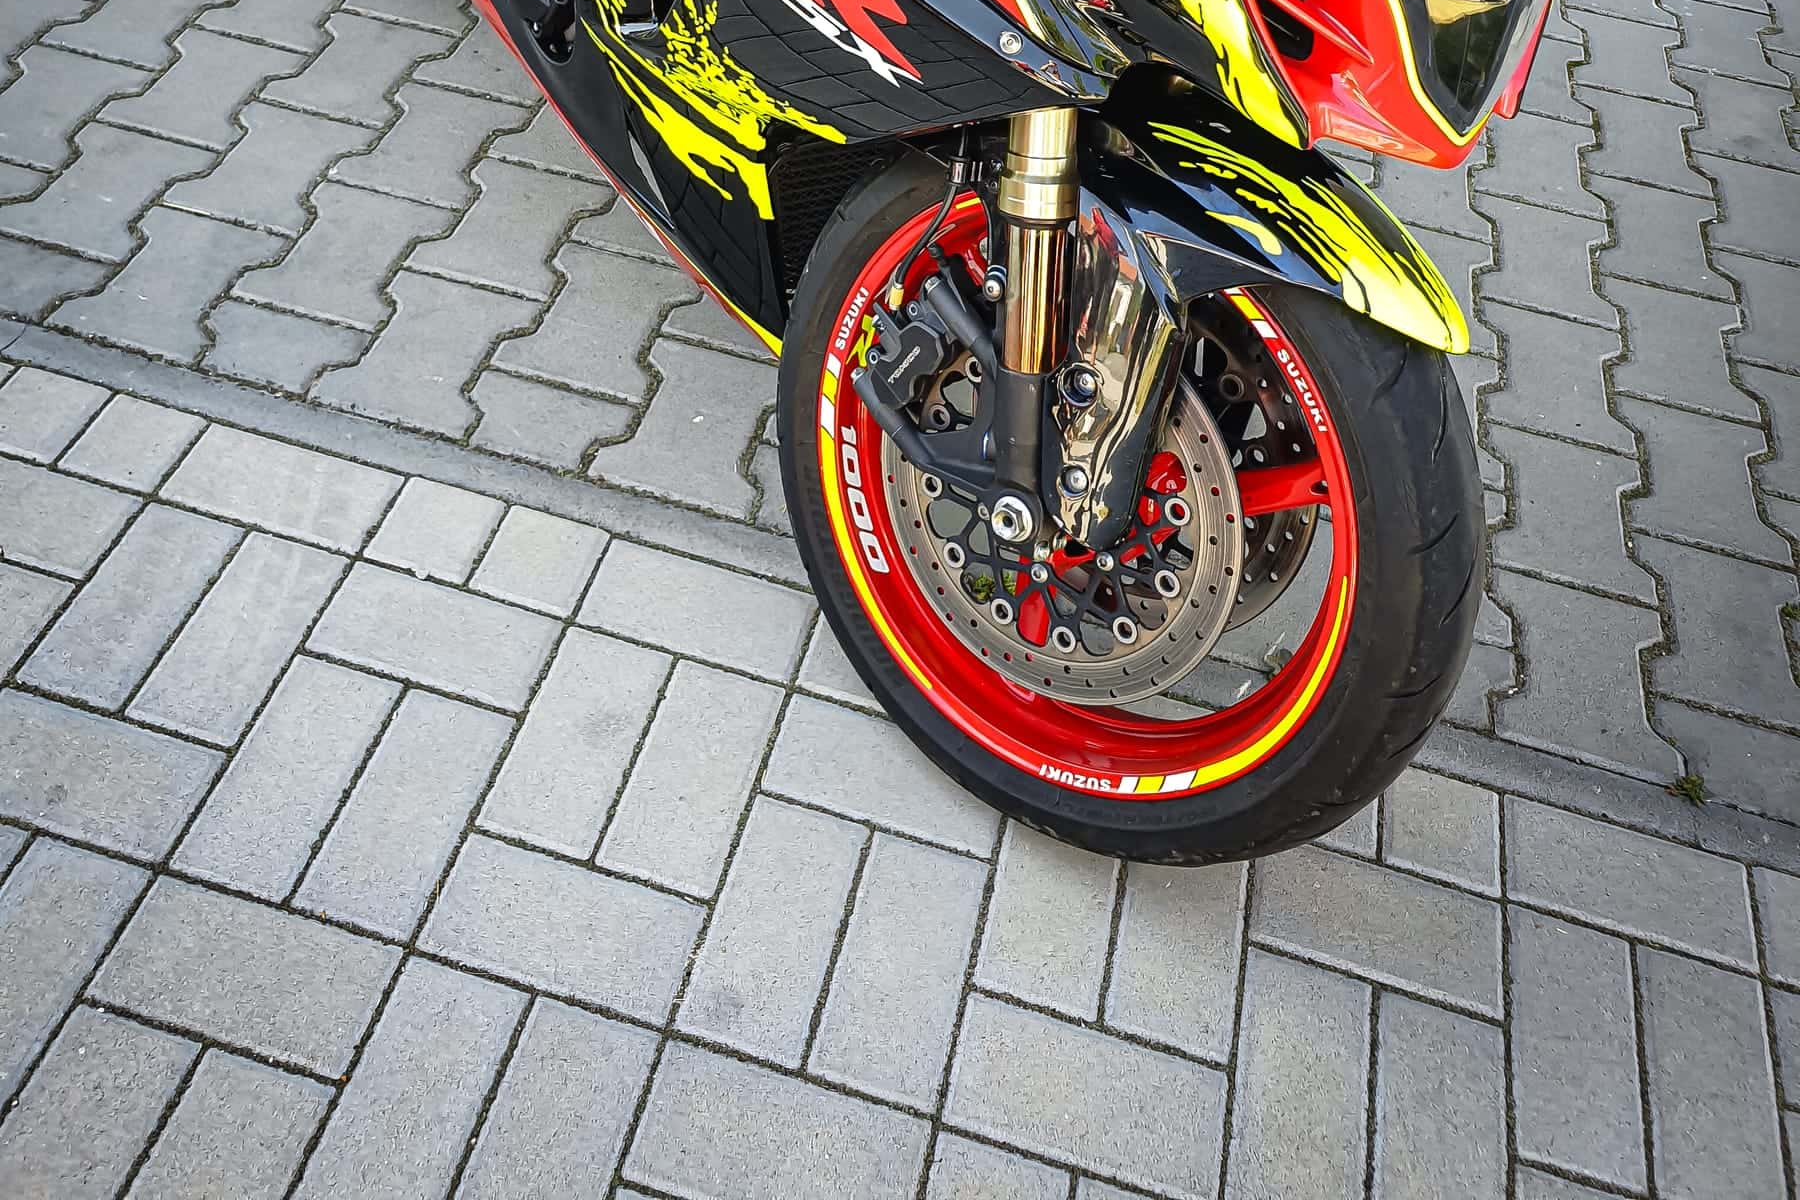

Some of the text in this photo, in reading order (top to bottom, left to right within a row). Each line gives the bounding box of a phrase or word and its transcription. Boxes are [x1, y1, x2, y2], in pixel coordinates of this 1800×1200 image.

[834, 286, 870, 351] SUZUKI
[1276, 348, 1329, 432] SUZUKI
[841, 425, 890, 574] 1000
[1039, 763, 1113, 792] SUZUKI
